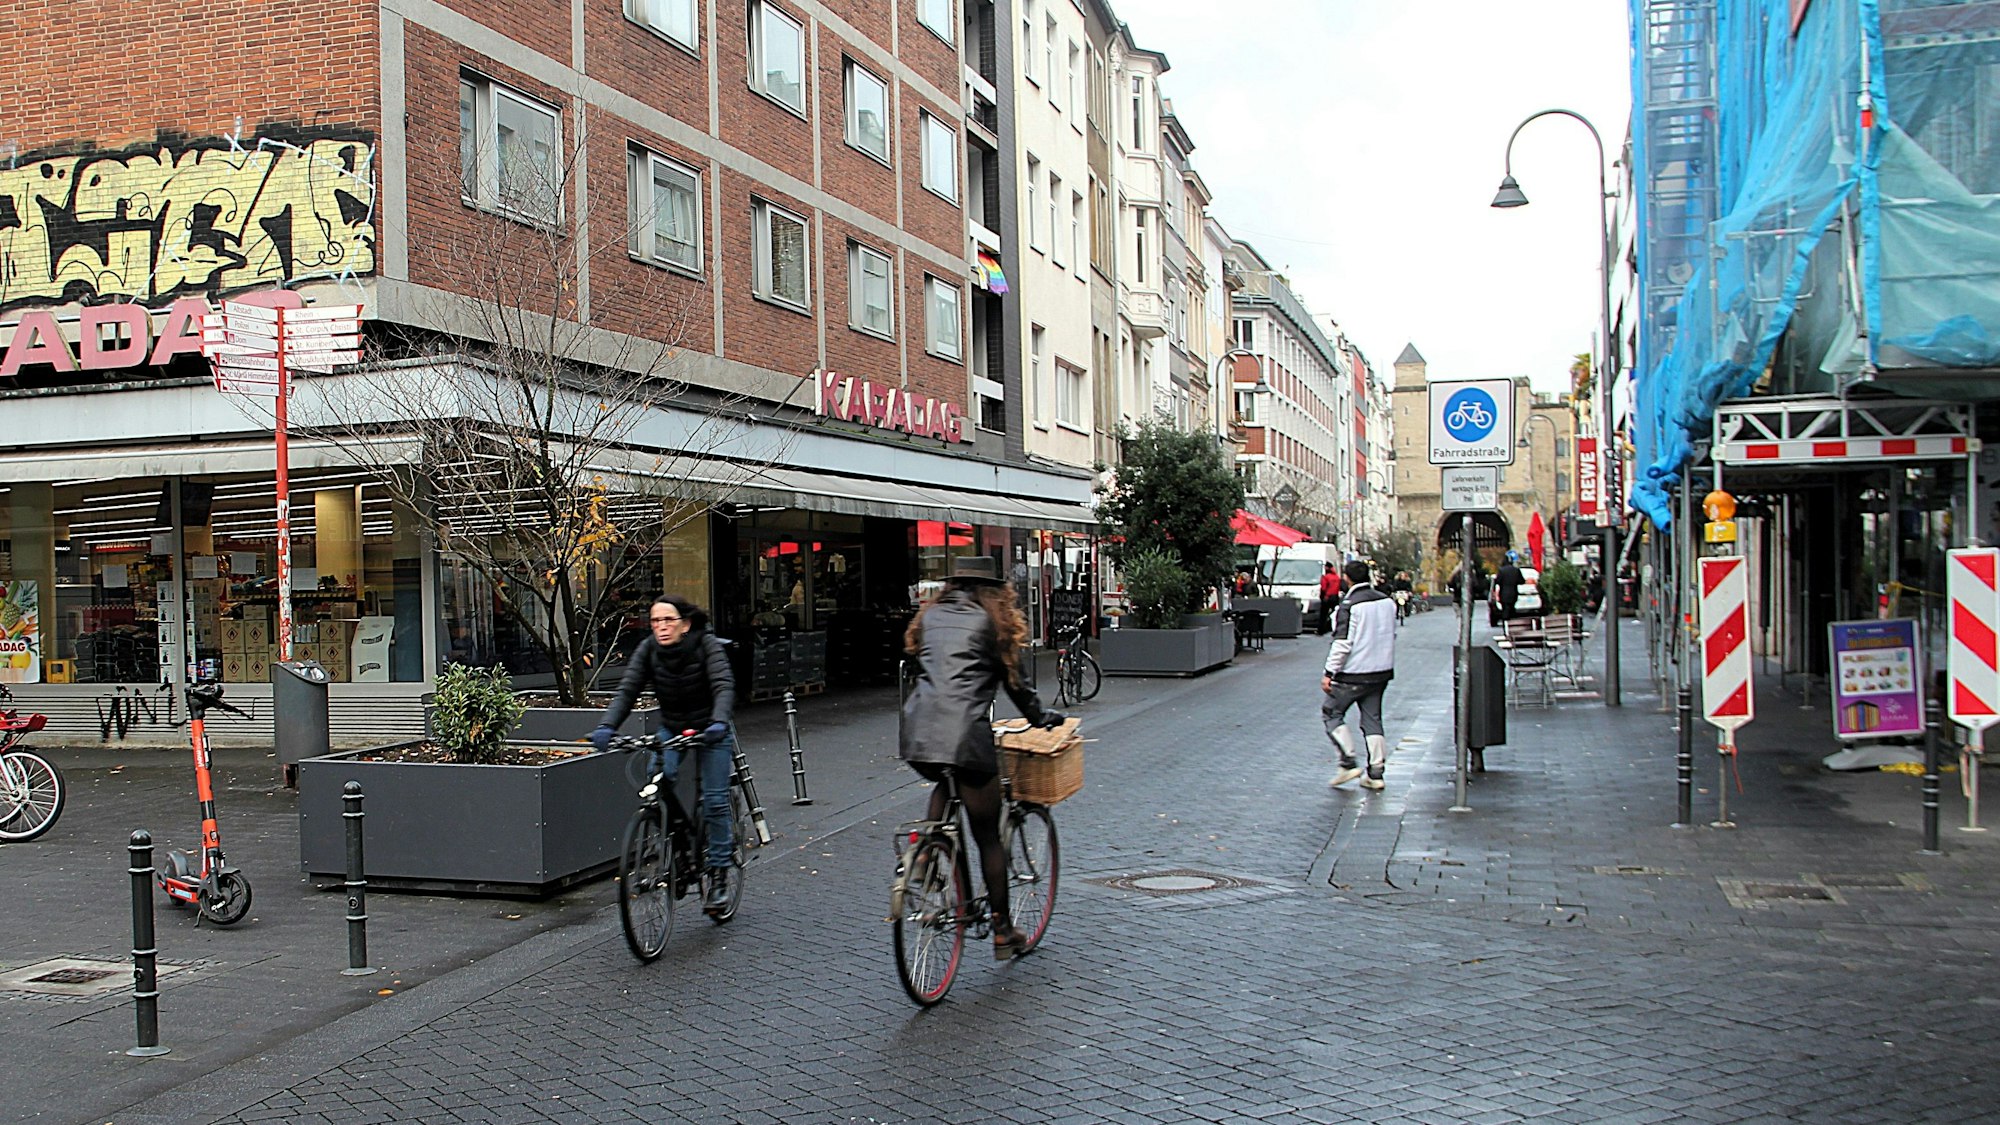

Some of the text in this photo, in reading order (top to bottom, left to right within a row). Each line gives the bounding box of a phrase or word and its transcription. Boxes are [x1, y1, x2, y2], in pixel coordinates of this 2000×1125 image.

[233, 305, 252, 315] Altstadt
[234, 320, 250, 330] Polizei
[330, 323, 352, 331] Christi
[236, 335, 247, 343] Dom
[295, 340, 334, 349] St. Kunibert
[228, 355, 266, 367] Hauptbahnhof
[248, 371, 277, 381] Himmelfahrt
[815, 369, 961, 444] KARADAG
[1433, 446, 1506, 458] Fahrradstraße
[1580, 451, 1596, 502] REWE
